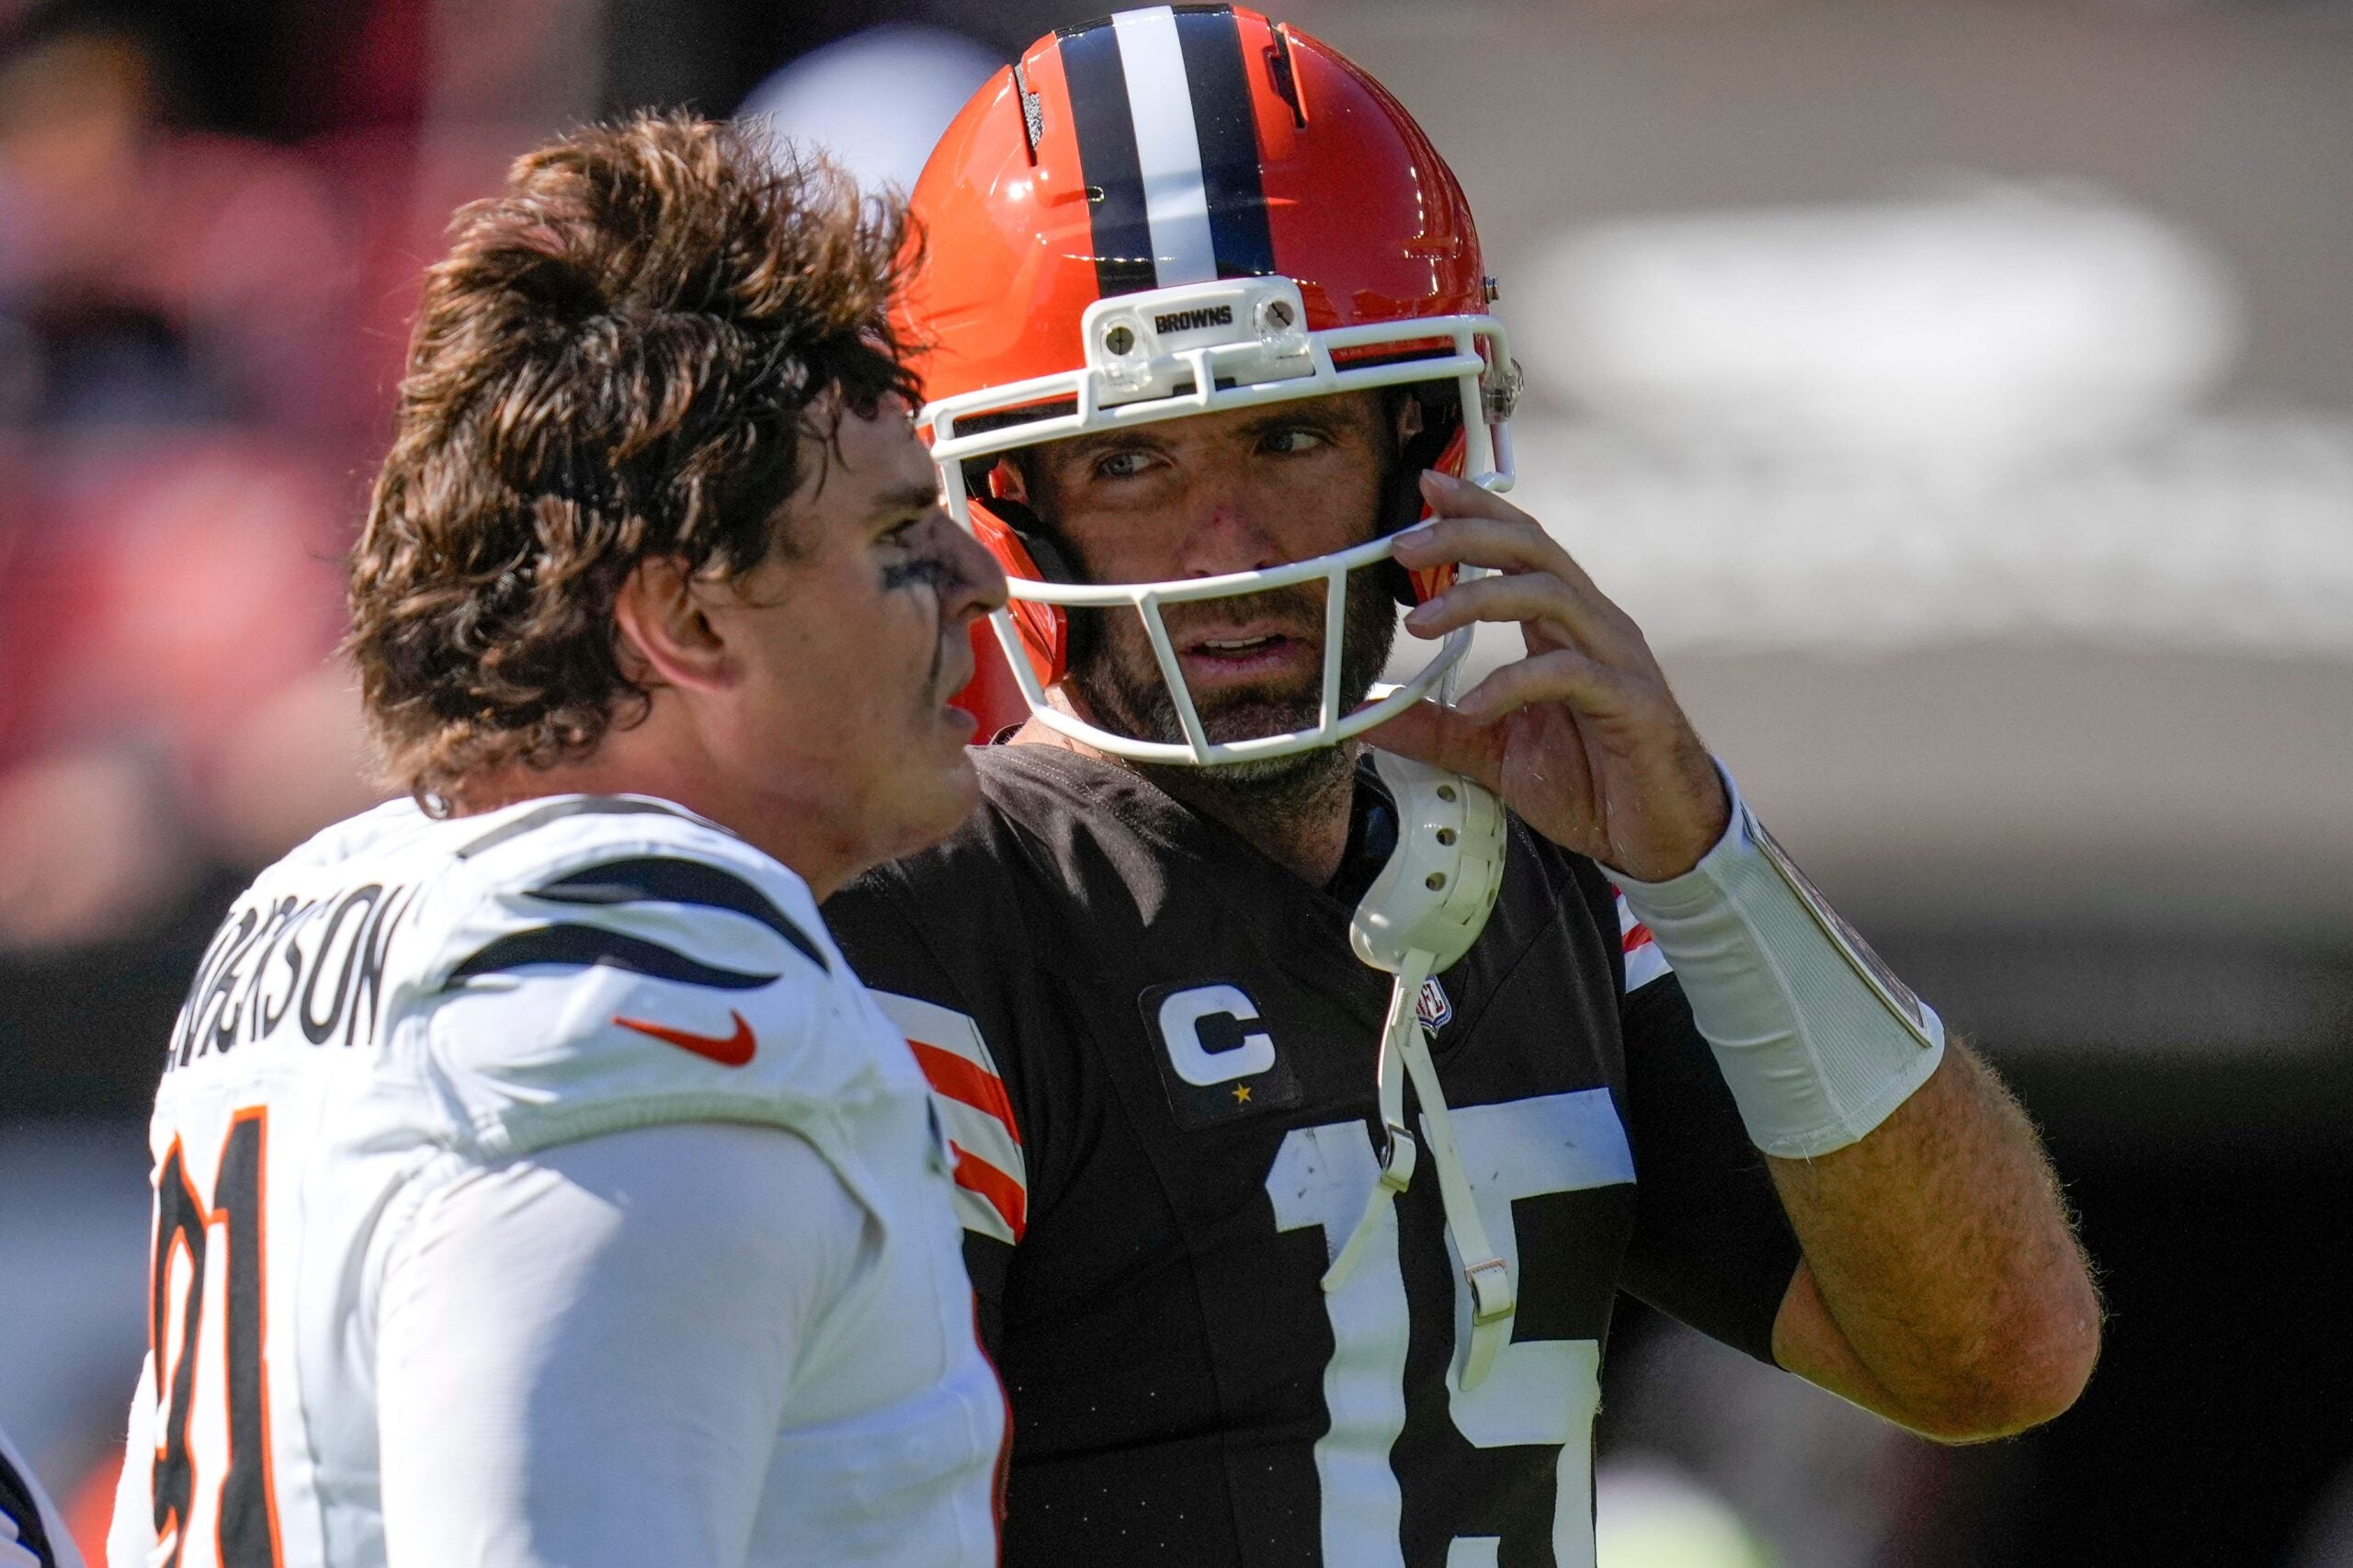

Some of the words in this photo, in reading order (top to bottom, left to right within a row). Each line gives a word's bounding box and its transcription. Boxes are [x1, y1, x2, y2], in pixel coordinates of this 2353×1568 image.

[1155, 305, 1233, 334] BROWNS
[1159, 983, 1277, 1086] C
[150, 1104, 285, 1568] 91
[1265, 1087, 1637, 1568] 15
